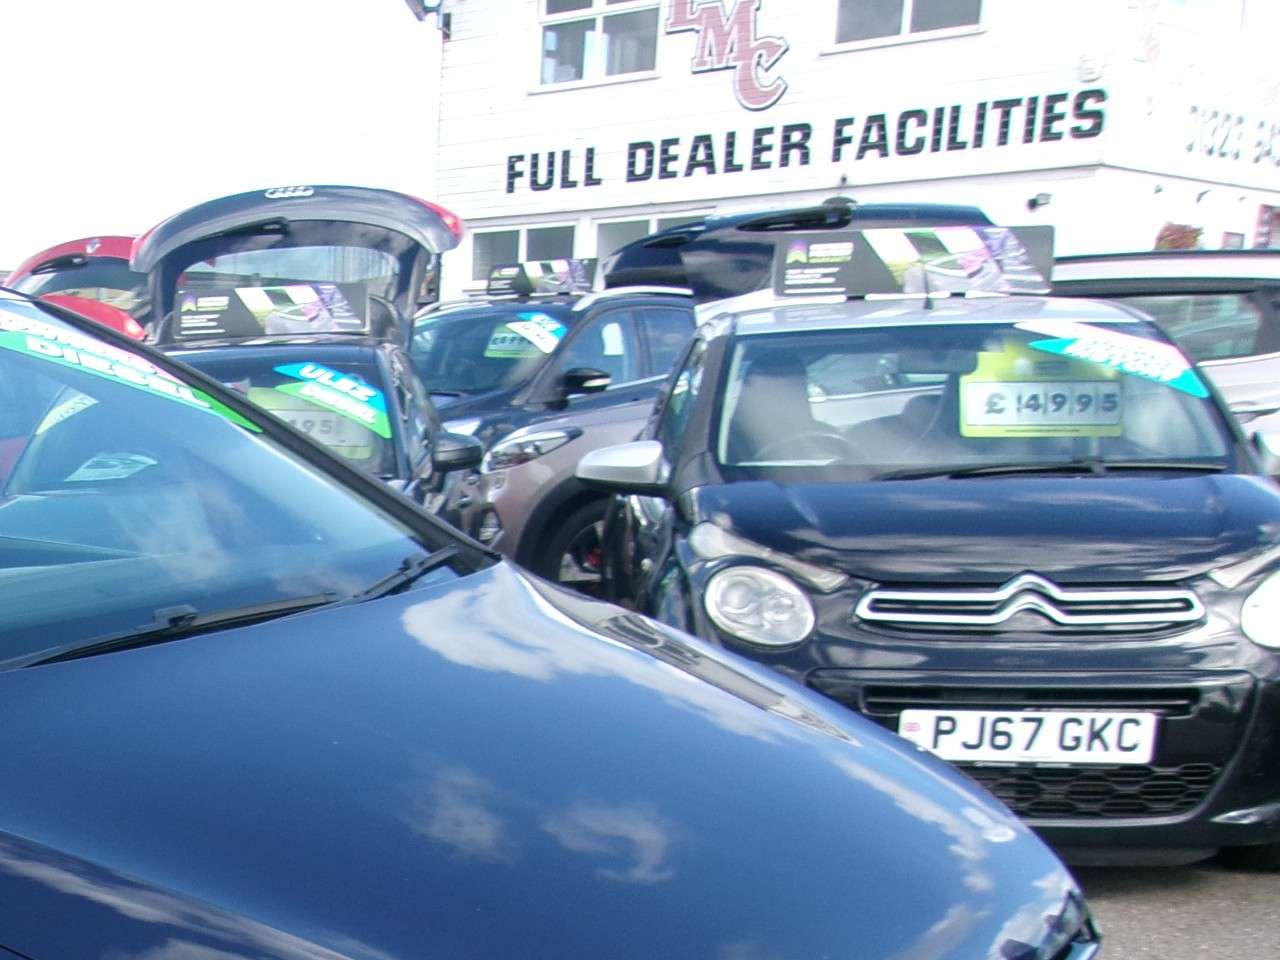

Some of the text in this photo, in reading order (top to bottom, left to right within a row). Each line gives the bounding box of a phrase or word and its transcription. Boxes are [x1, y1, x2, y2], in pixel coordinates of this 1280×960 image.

[506, 88, 1109, 194] FULL DEALER FACILITIES
[299, 363, 377, 402] ULEZ
[932, 715, 1141, 752] PJ67 GKC
